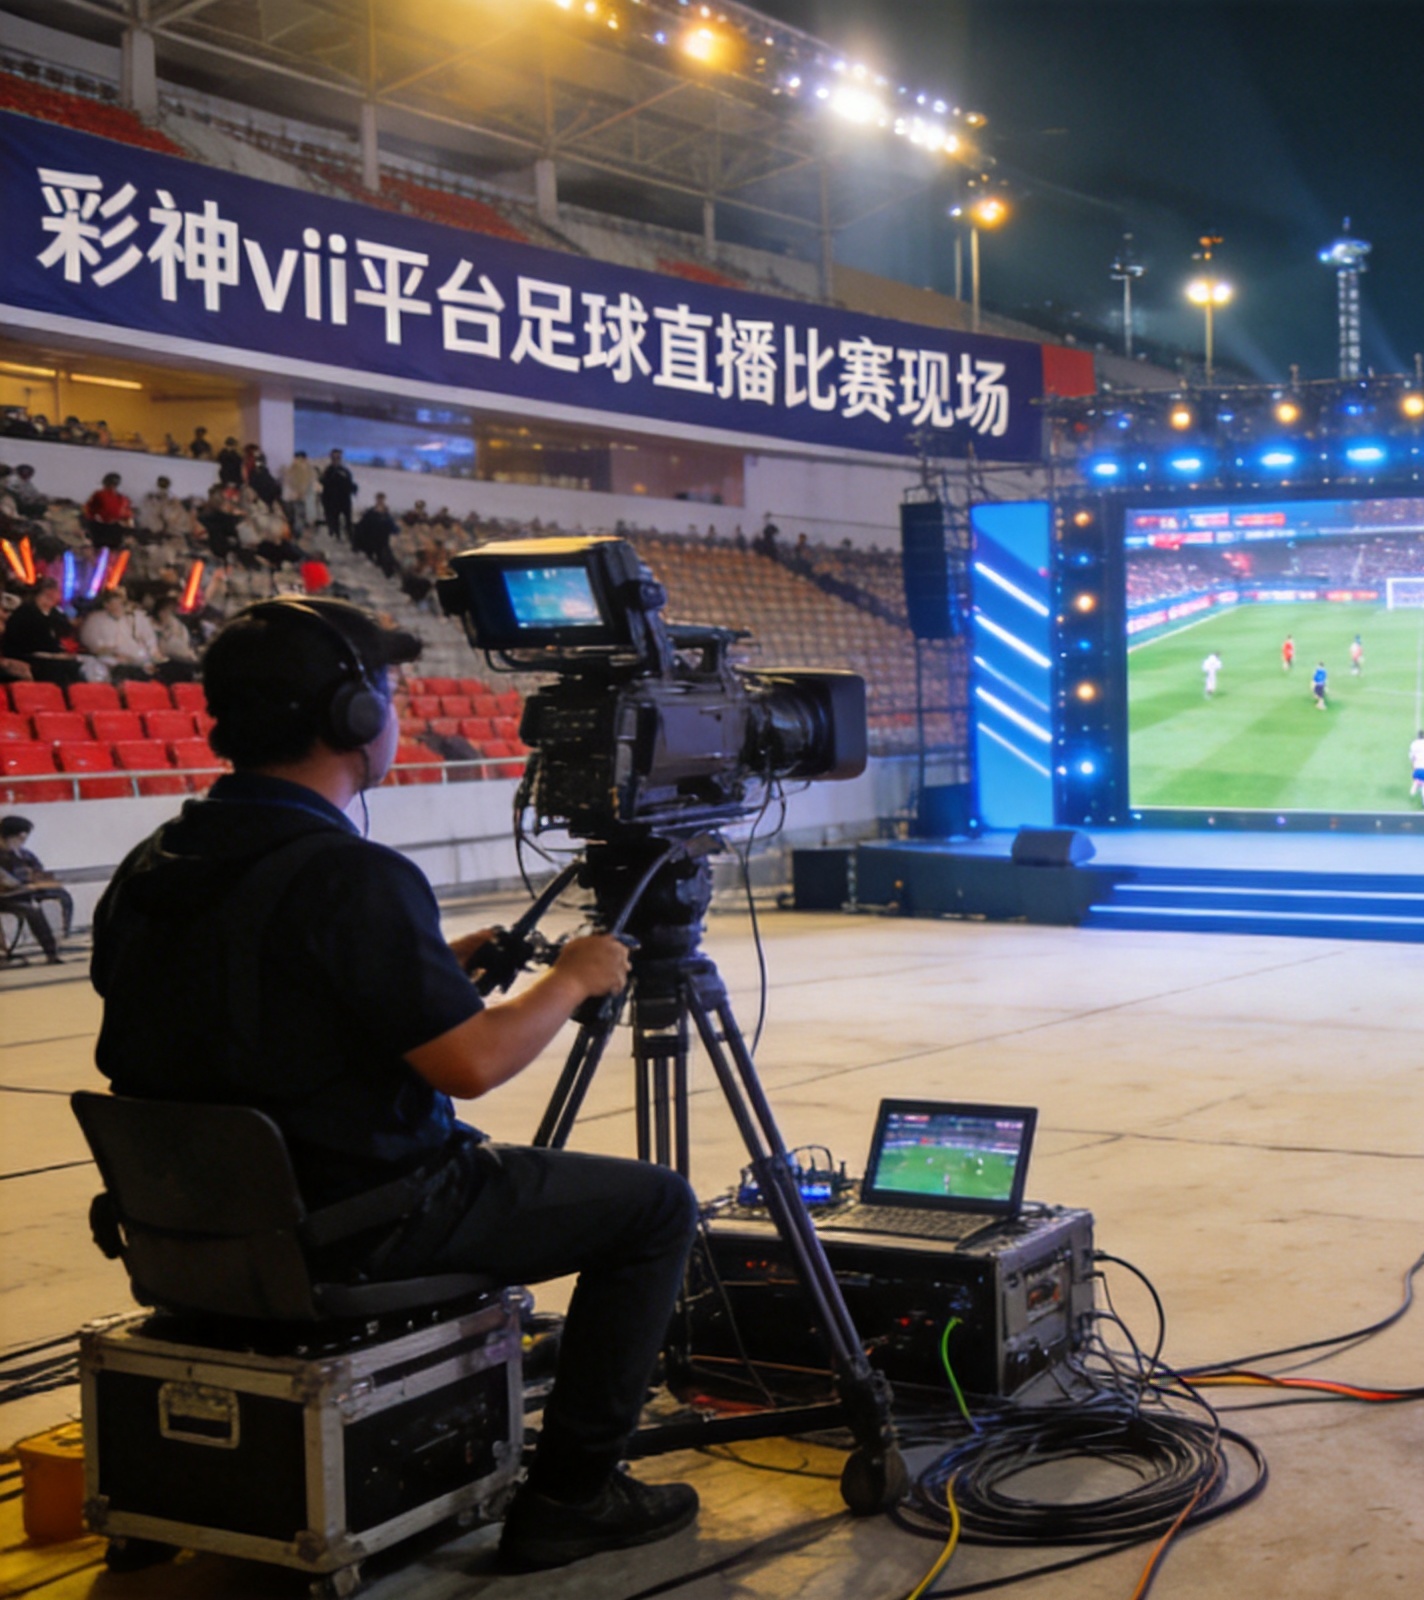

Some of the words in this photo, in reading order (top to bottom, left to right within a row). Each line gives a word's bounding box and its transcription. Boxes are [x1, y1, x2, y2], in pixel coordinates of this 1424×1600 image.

[36, 167, 1010, 438] 彩神vii平台足球直播比赛现场
